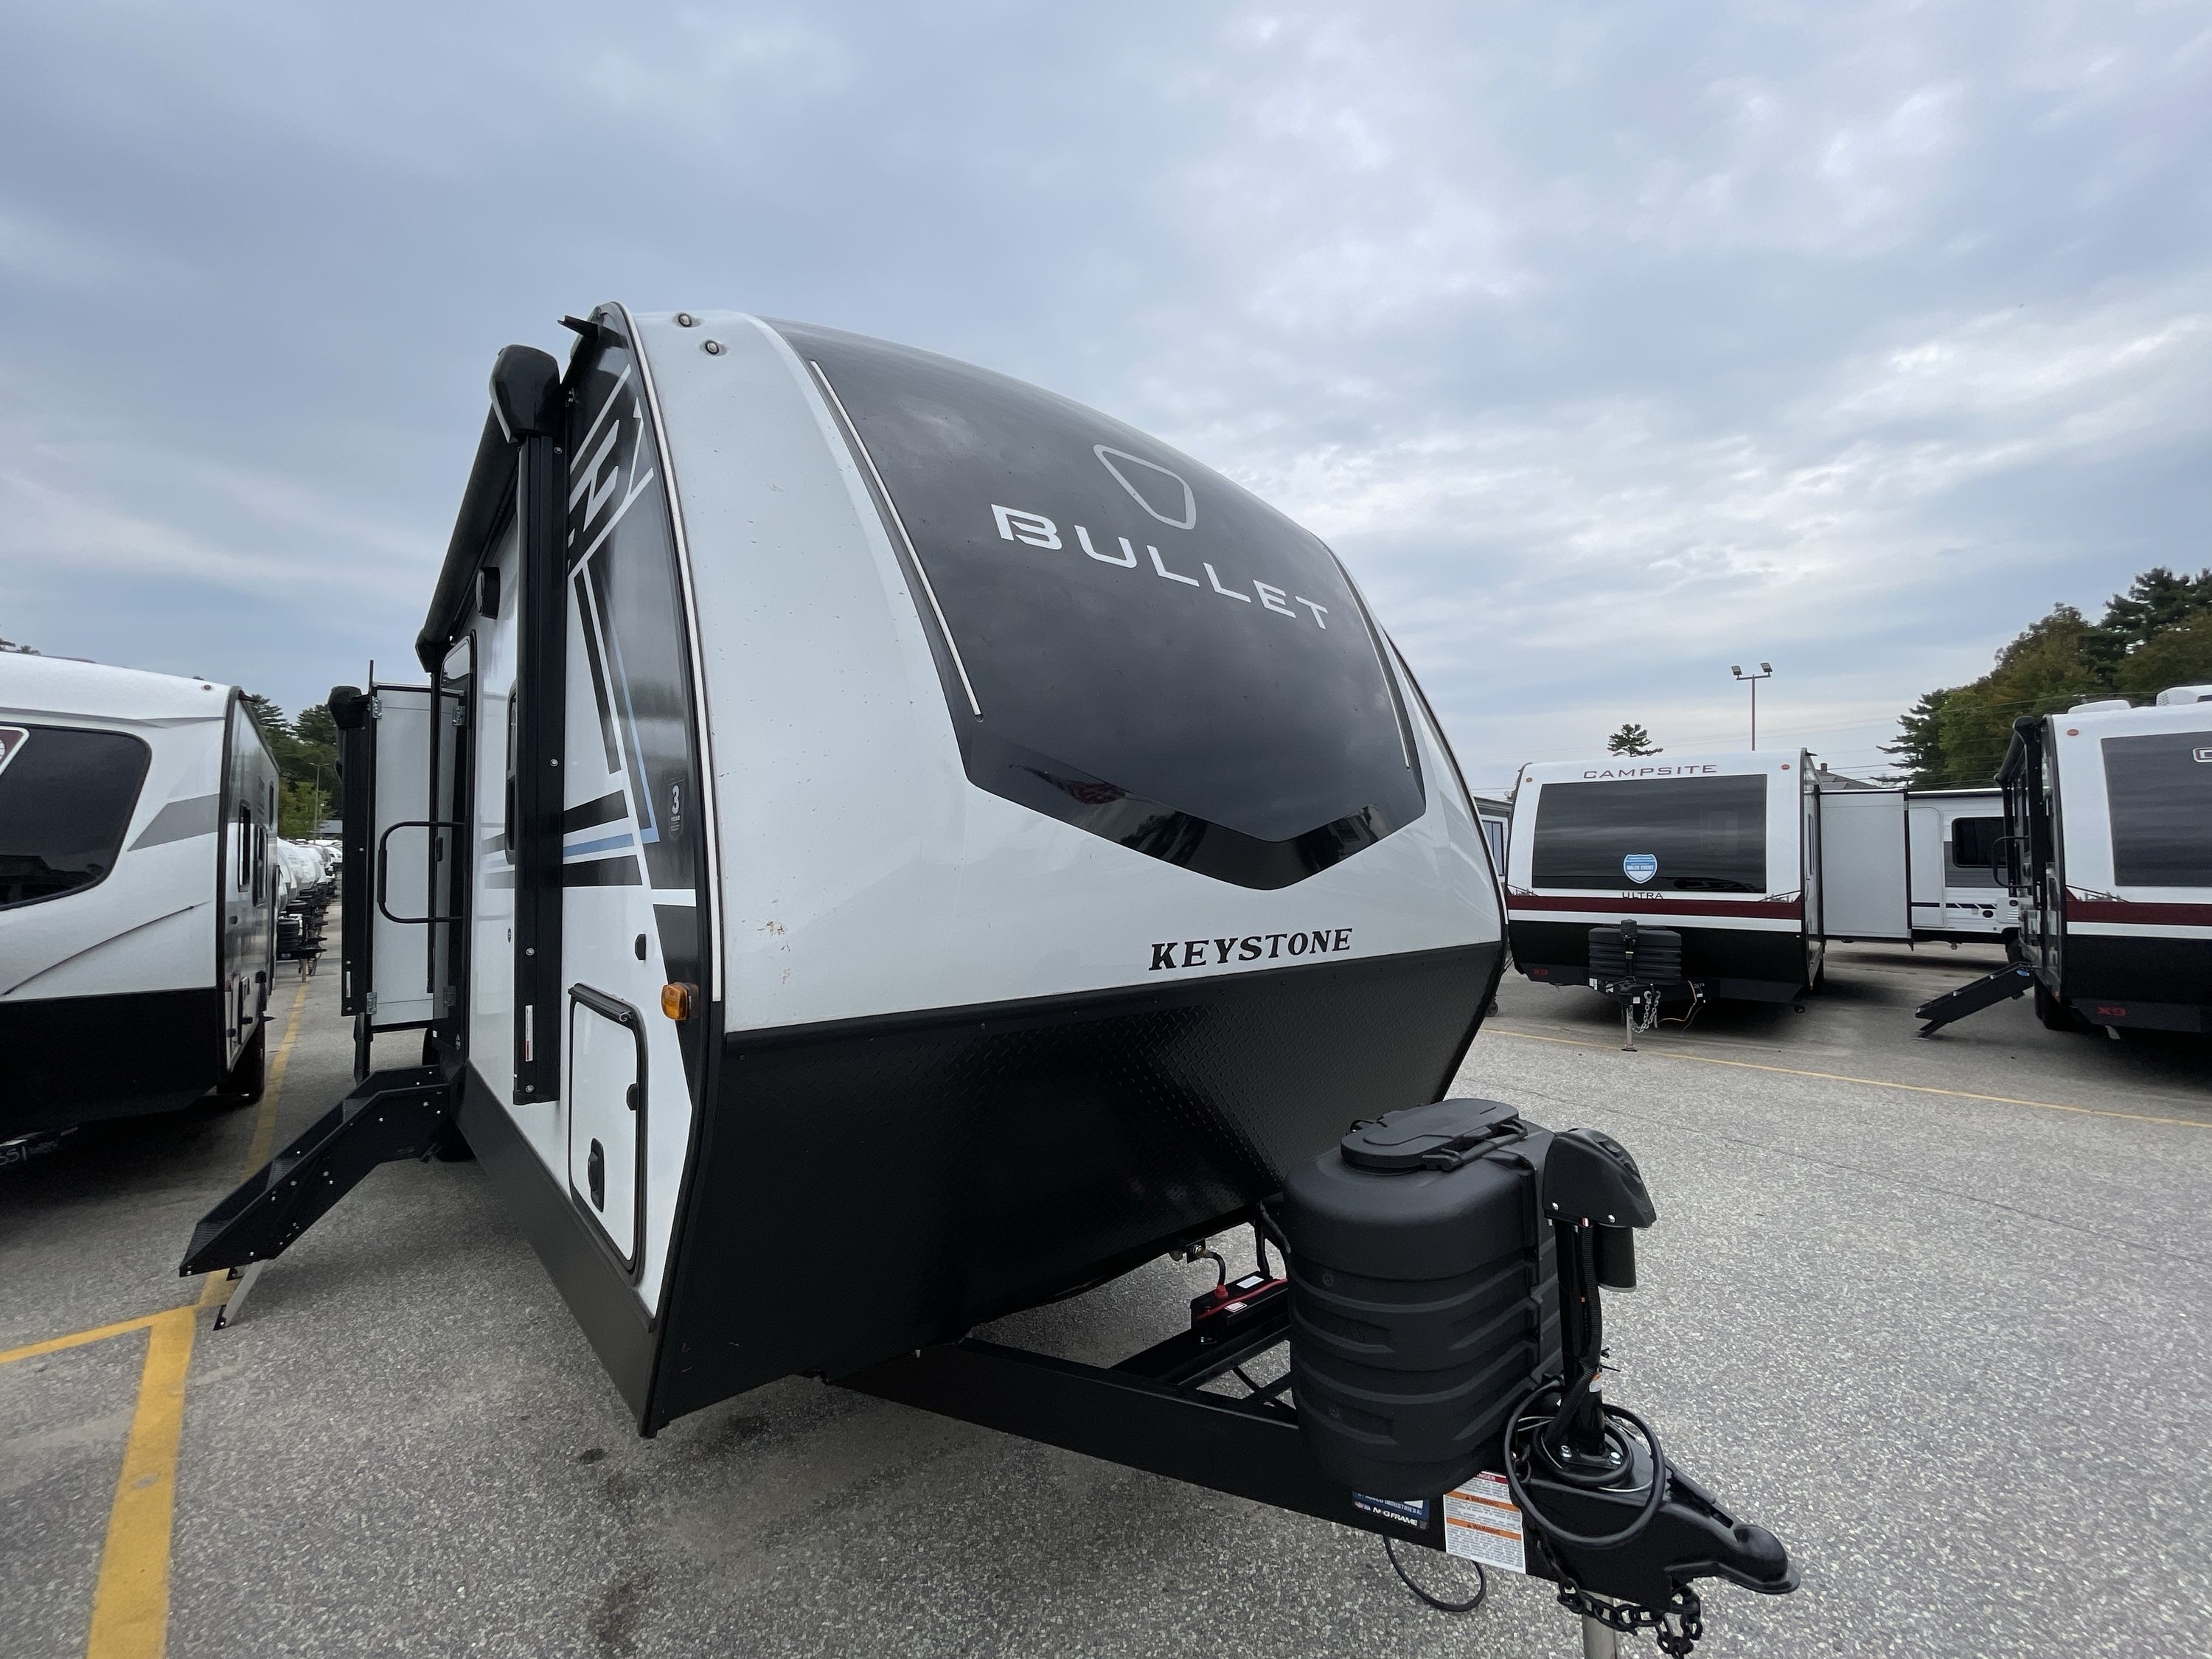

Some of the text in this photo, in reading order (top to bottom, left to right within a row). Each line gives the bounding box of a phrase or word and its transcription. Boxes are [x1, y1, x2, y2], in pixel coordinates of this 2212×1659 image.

[990, 504, 1329, 630] BULLET
[1583, 764, 1718, 779] CAMPSITE
[672, 785, 679, 814] 3
[1622, 891, 1664, 900] ULTRA
[1148, 928, 1352, 971] KEYSTONE
[1391, 1512, 1419, 1526] FRAME
